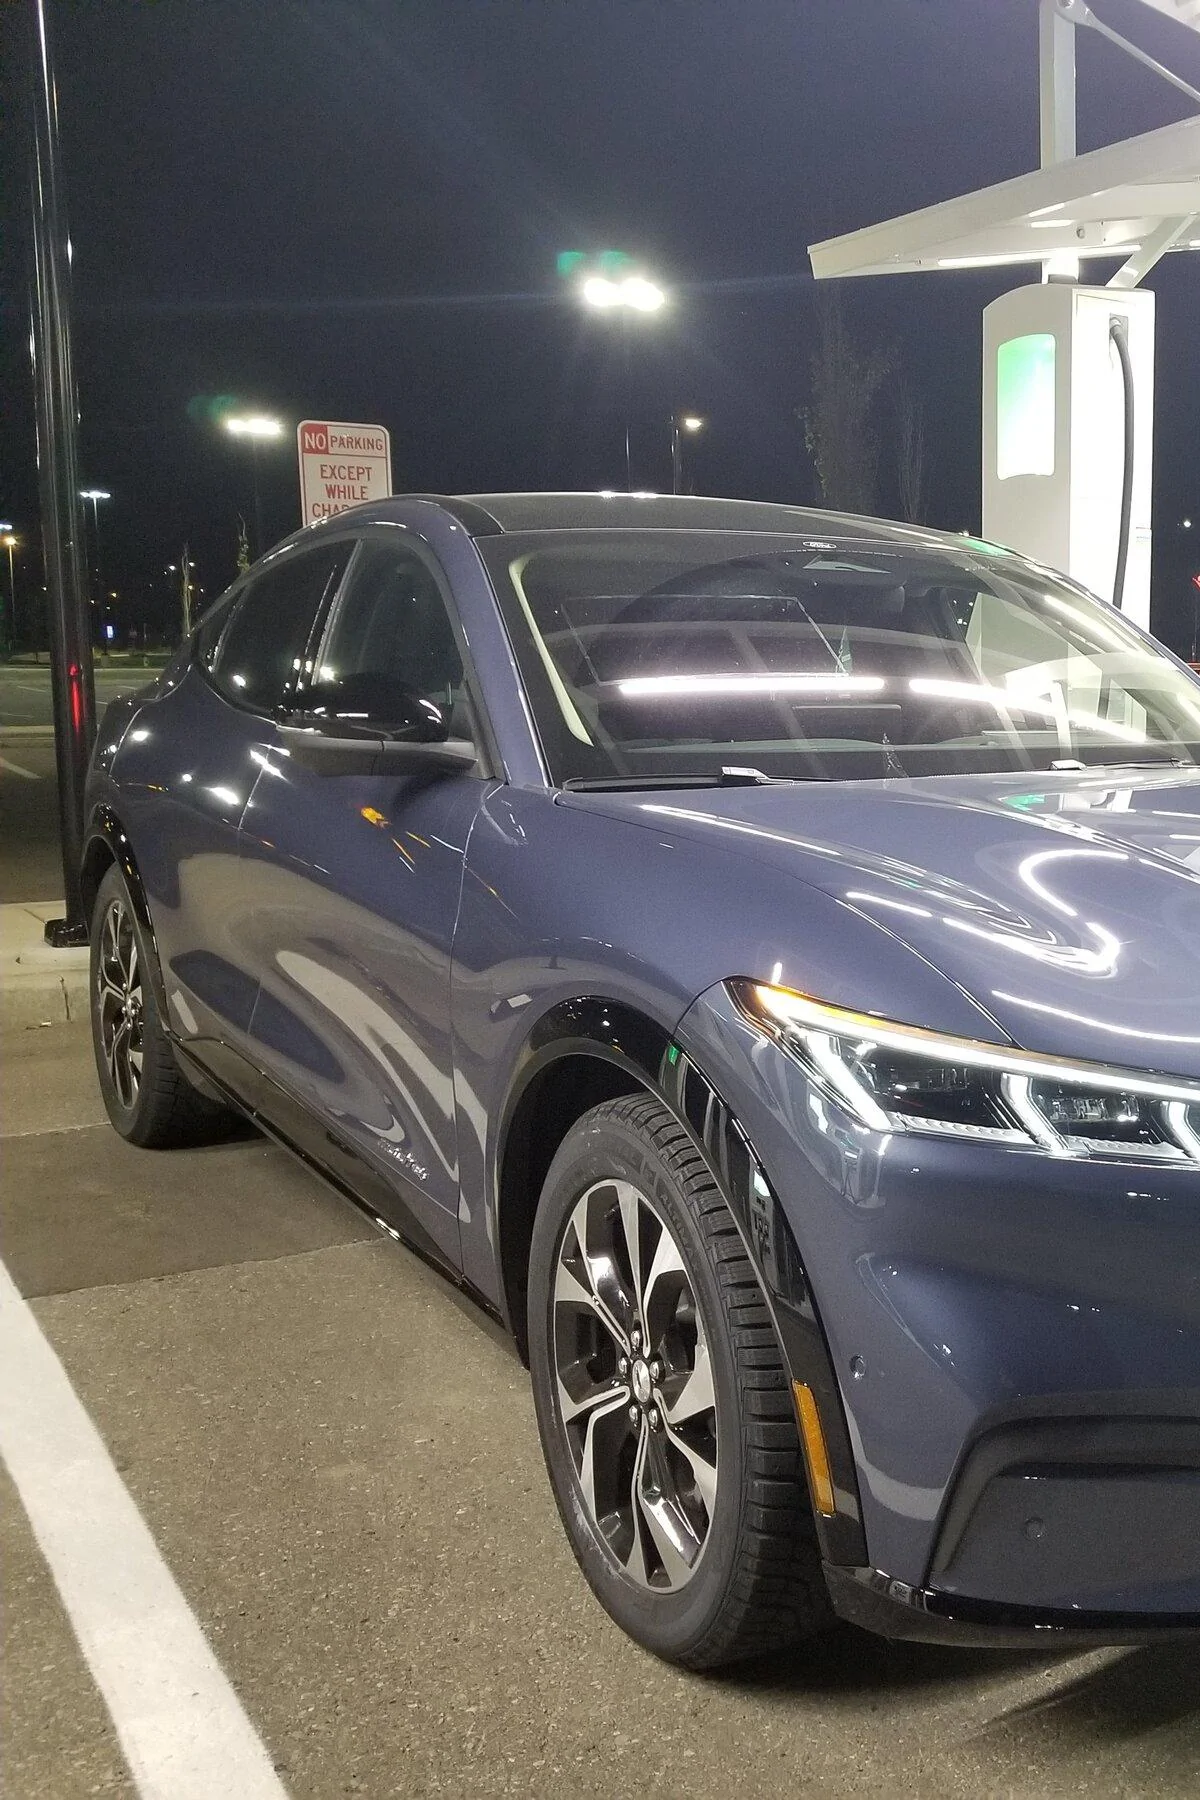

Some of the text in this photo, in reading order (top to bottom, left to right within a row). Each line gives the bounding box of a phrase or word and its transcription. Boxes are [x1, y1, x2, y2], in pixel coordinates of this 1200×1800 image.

[304, 432, 384, 451] NO PARKING
[320, 464, 372, 481] EXCEPT
[325, 484, 369, 500] WHILE
